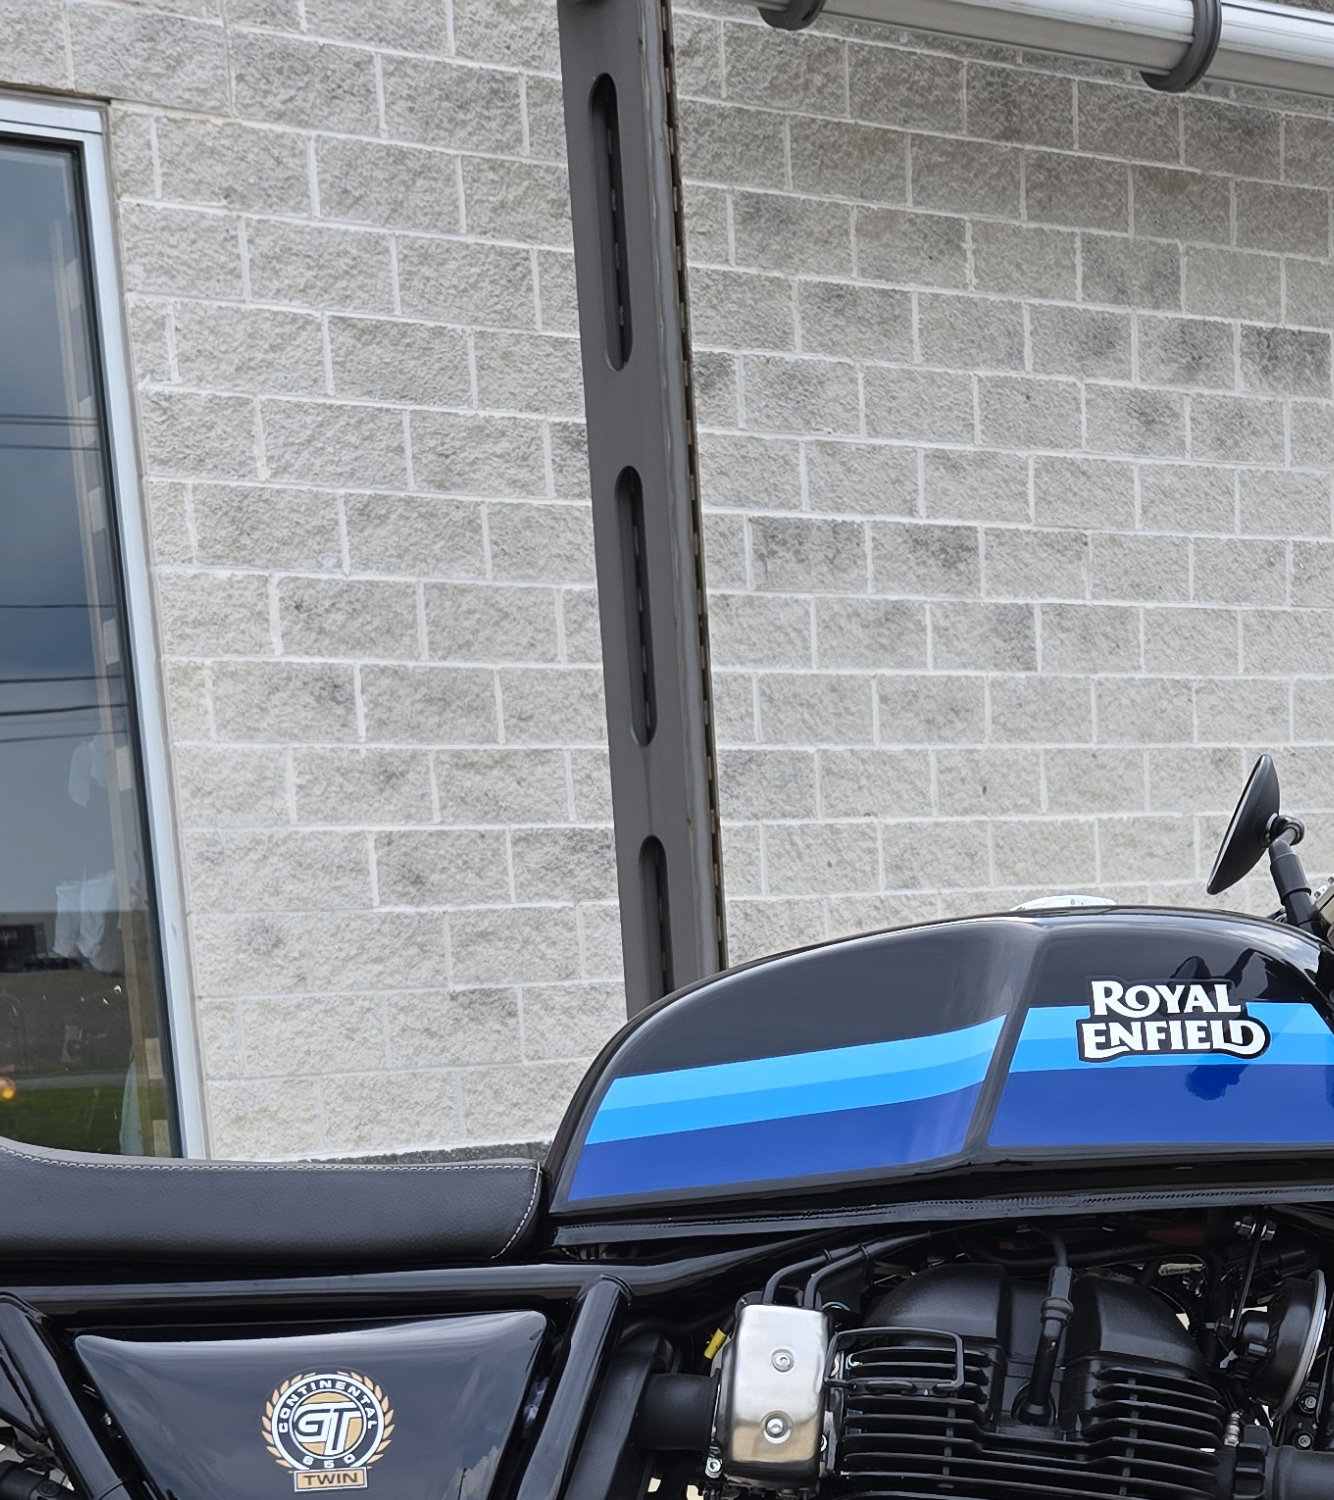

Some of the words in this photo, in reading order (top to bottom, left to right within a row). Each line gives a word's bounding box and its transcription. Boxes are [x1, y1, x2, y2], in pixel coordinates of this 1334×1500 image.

[1090, 980, 1242, 1018] ROYAL
[1081, 1019, 1267, 1060] ENFIELD
[279, 1379, 378, 1433] CONTINENTAL
[294, 1401, 363, 1456] GT
[302, 1453, 357, 1469] 650
[303, 1472, 359, 1487] TWIN
